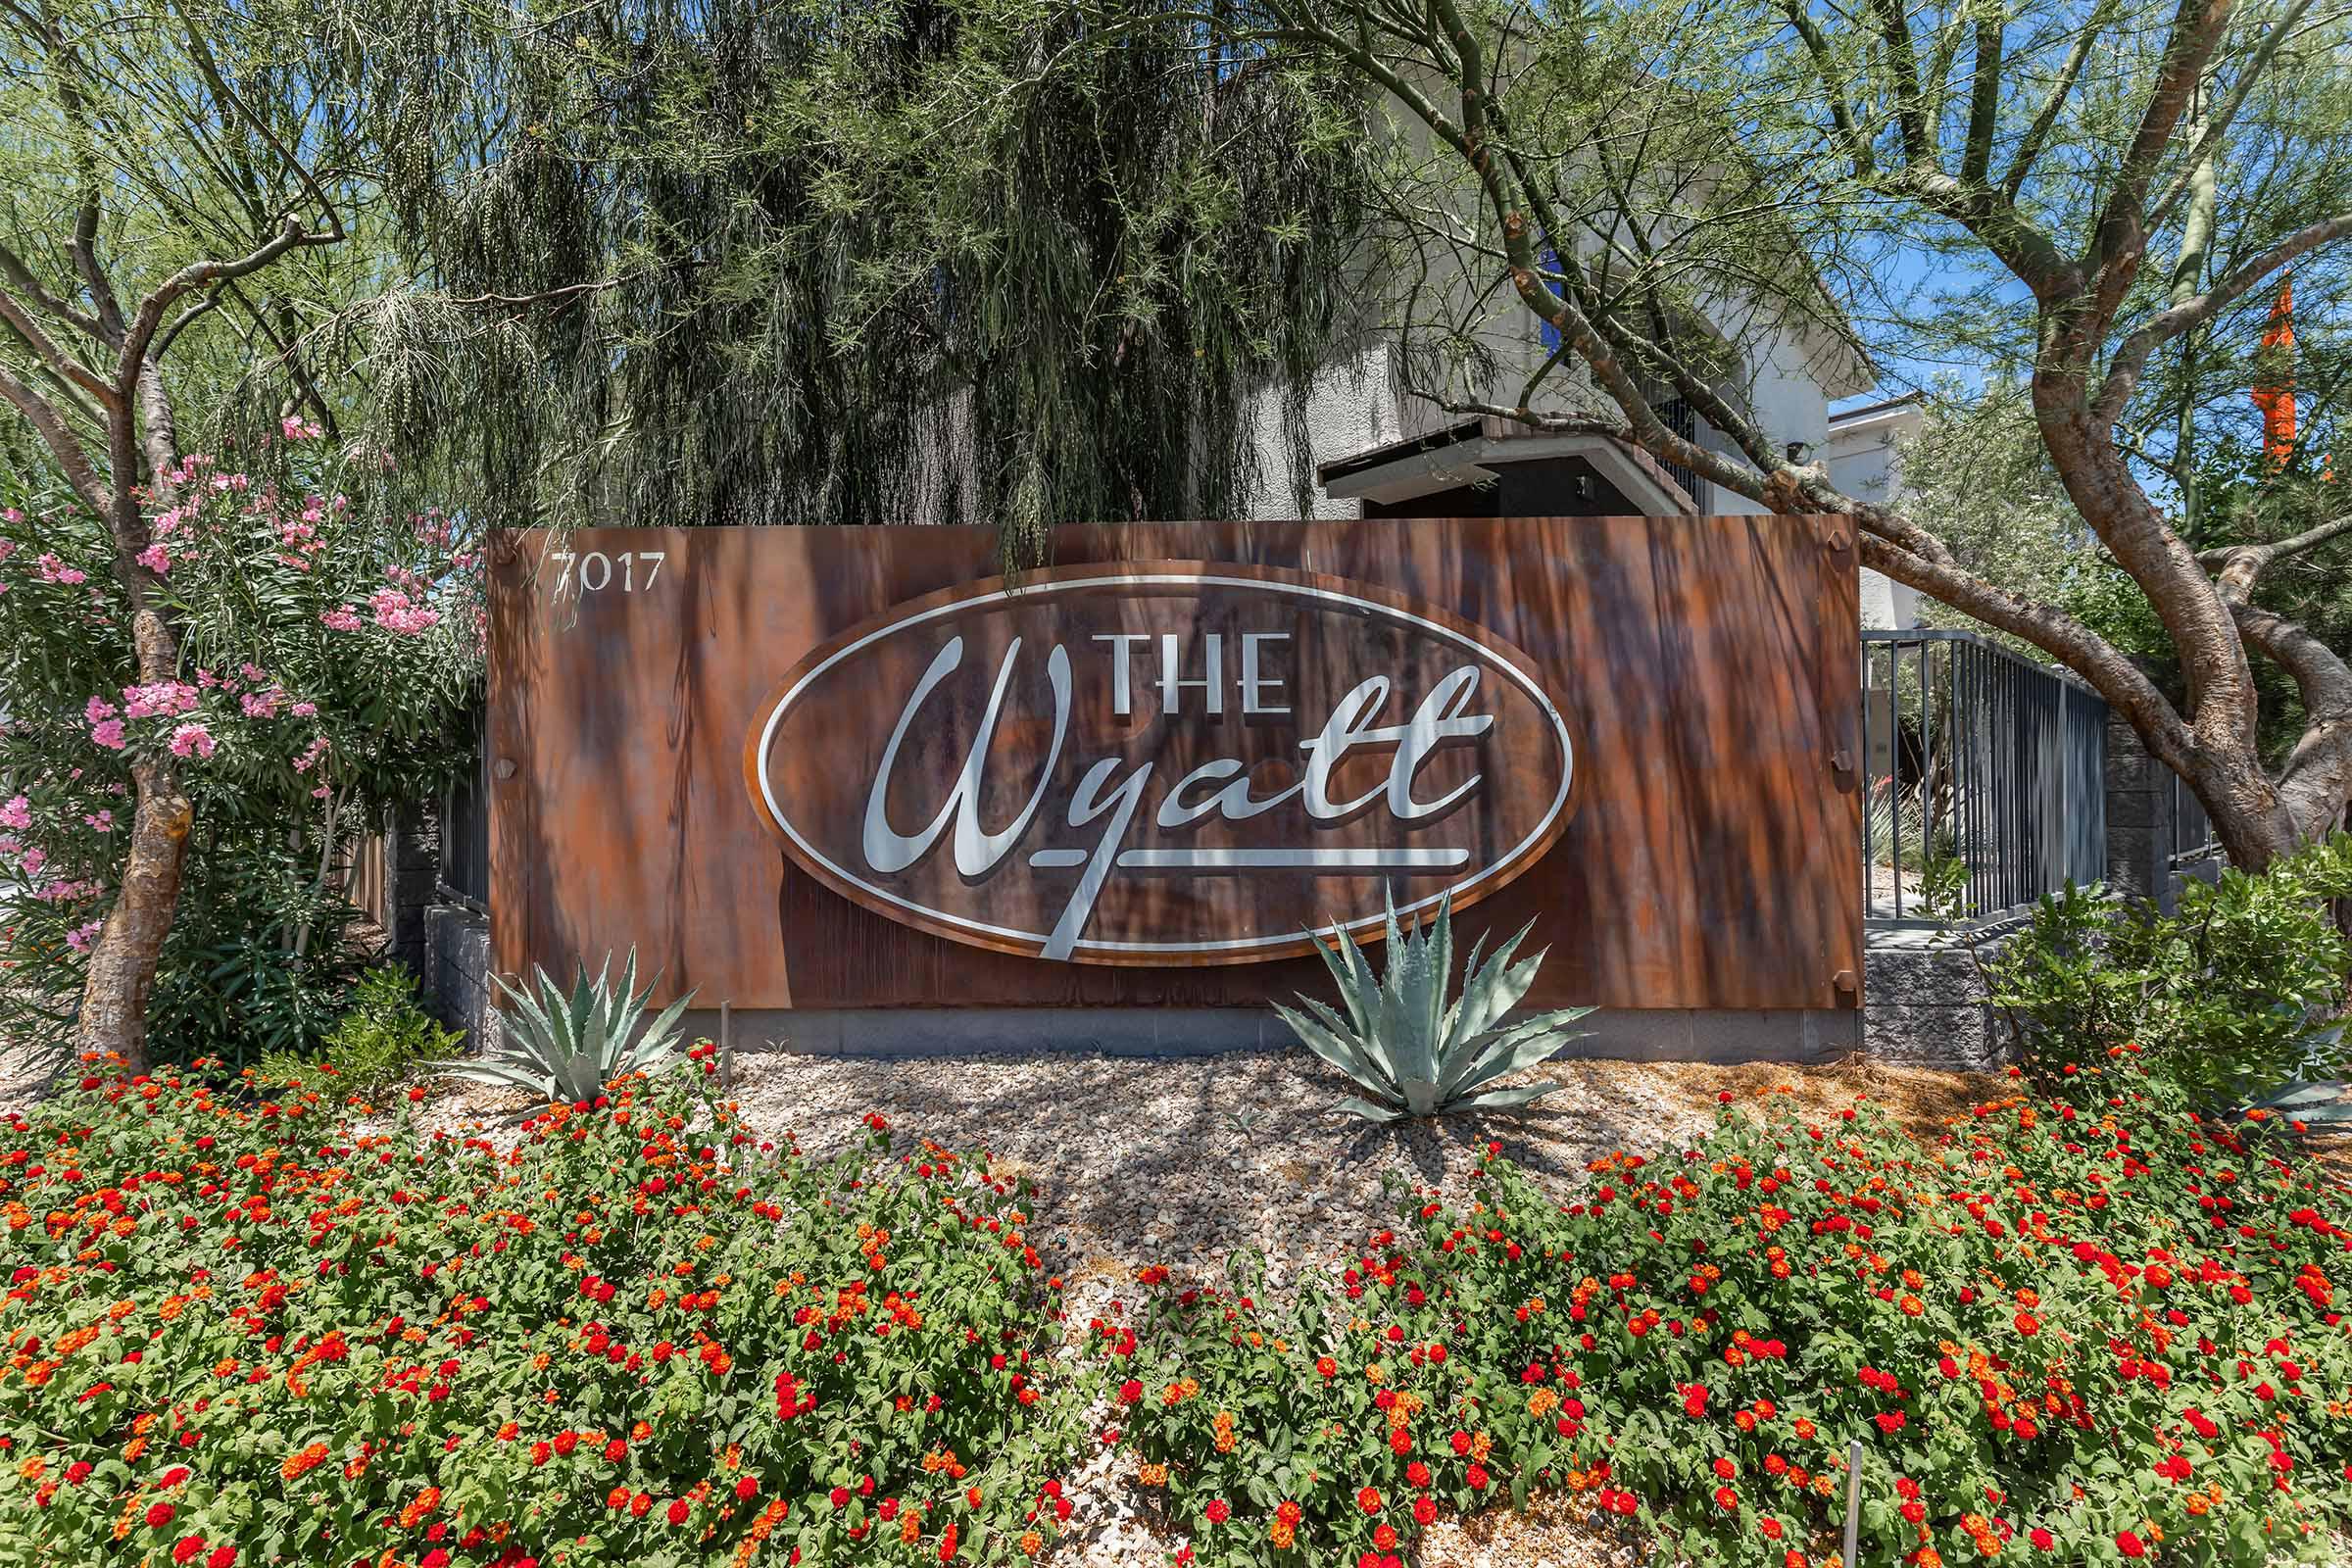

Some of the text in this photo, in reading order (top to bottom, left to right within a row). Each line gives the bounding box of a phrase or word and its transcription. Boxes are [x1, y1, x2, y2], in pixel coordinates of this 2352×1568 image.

[551, 551, 665, 592] 7017
[1092, 633, 1292, 715] THE
[862, 635, 1494, 960] Wyatt
